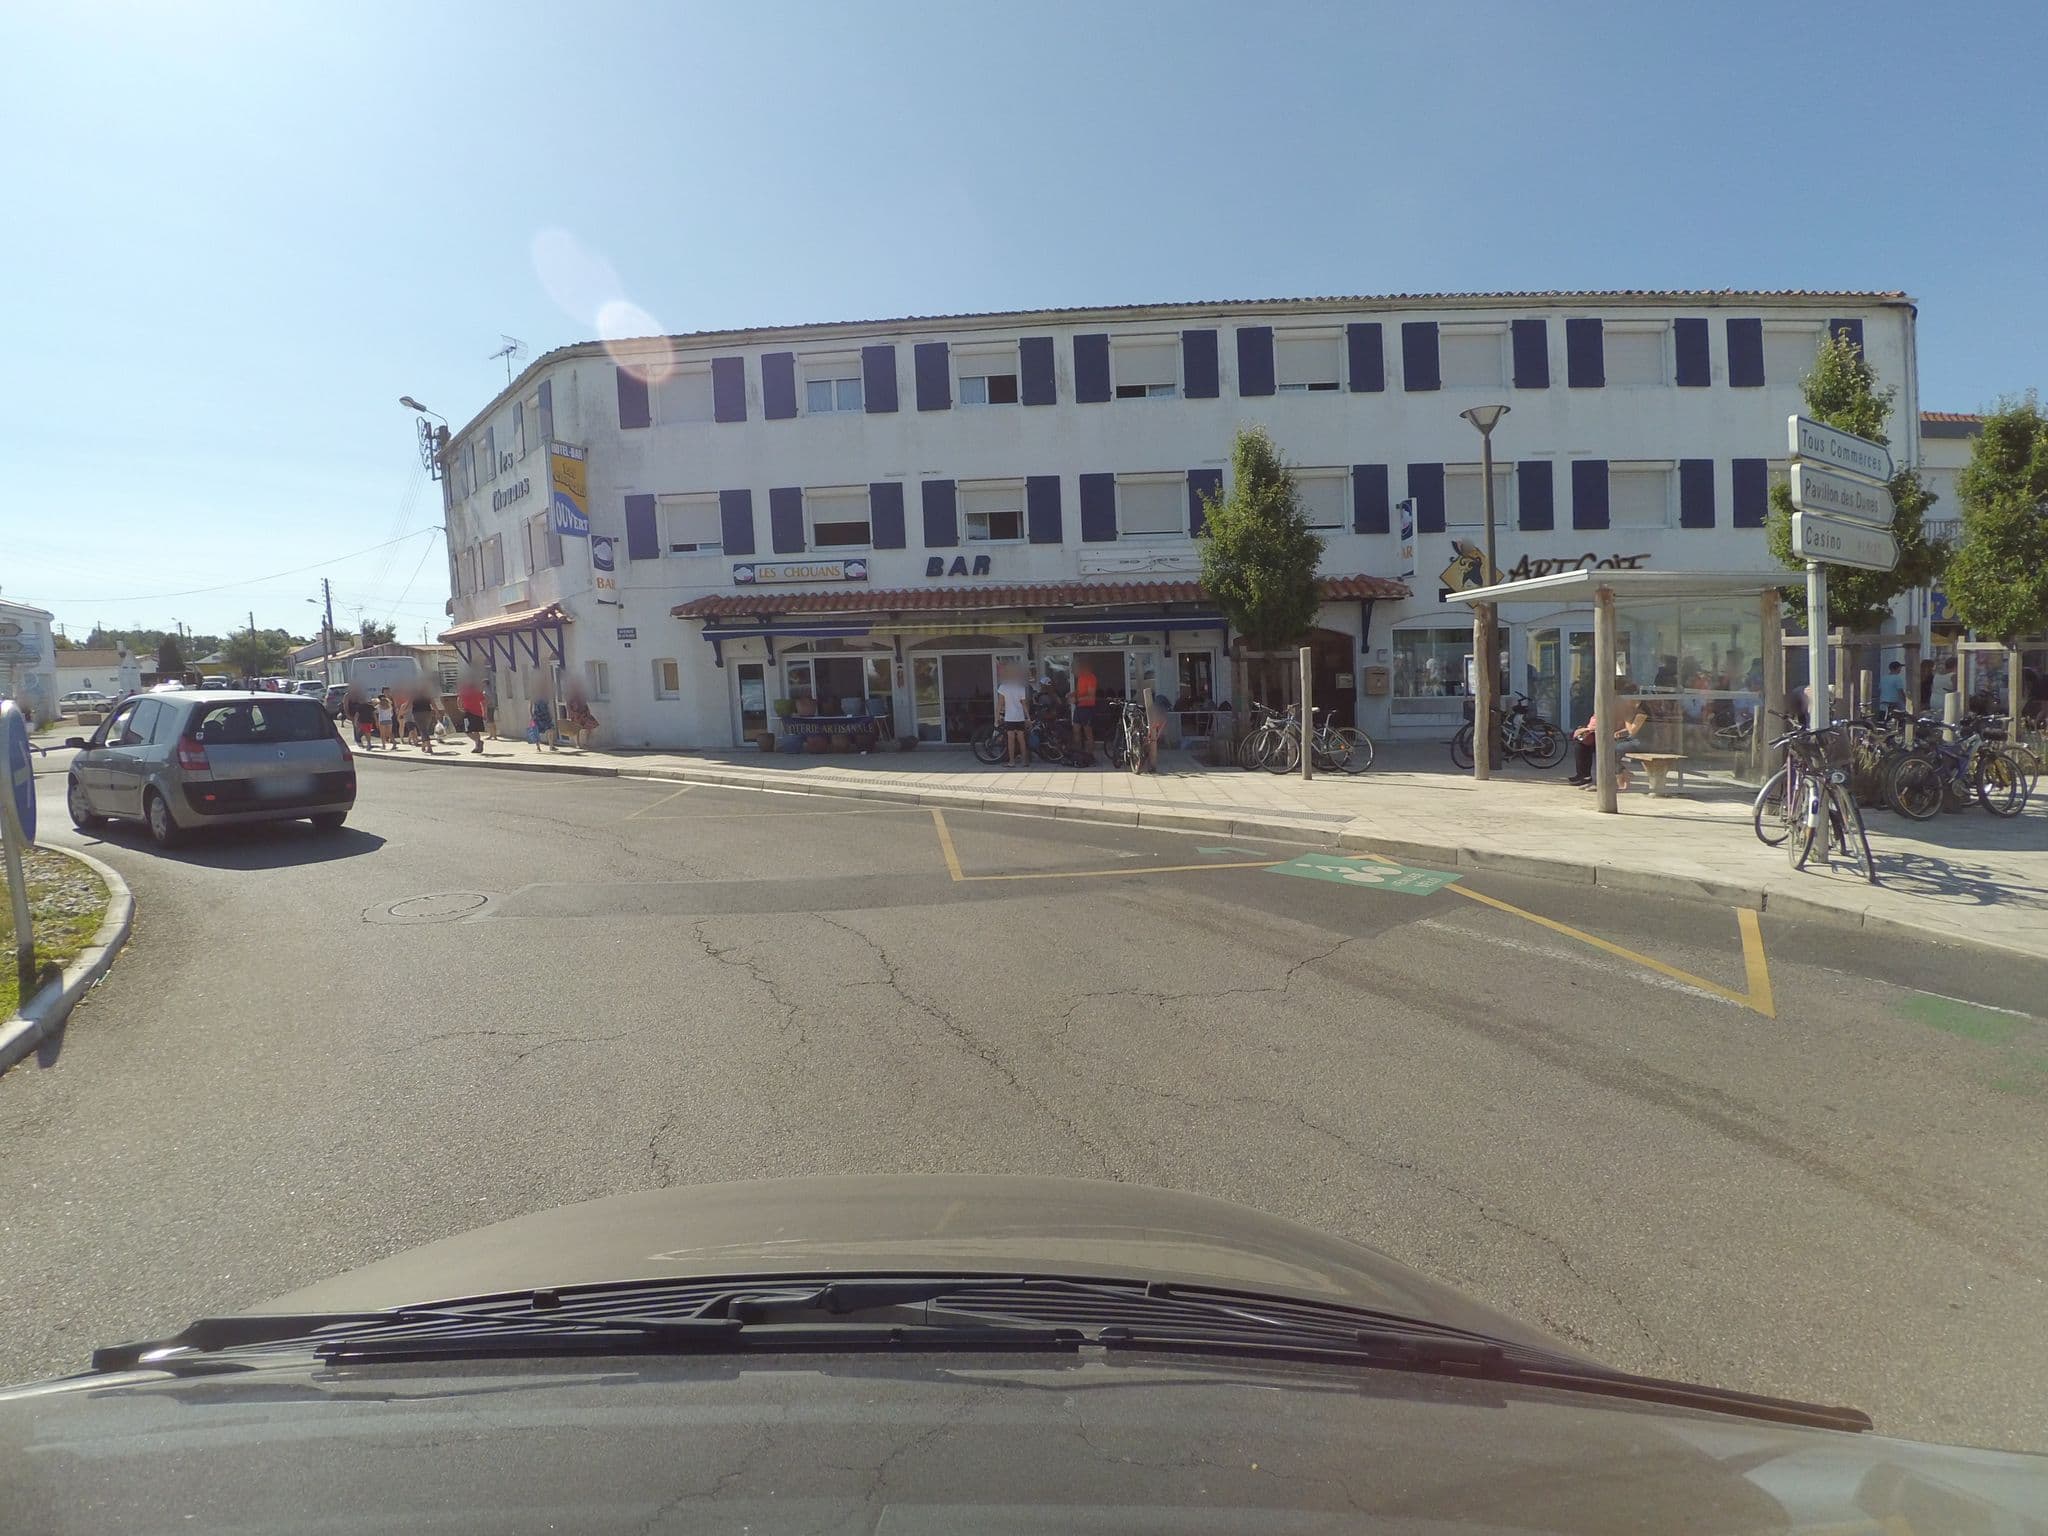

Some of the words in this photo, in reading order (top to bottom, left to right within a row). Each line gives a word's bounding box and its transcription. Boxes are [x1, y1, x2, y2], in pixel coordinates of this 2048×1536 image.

[1802, 429, 1825, 453] Tous
[1830, 438, 1882, 472] Commerces
[1805, 478, 1838, 503] Pavillon
[1840, 489, 1853, 507] des
[555, 500, 588, 531] OUVERT
[1806, 526, 1841, 550] Casino
[759, 569, 776, 578] LES
[783, 565, 840, 578] CHOUANS
[925, 556, 992, 577] BAR
